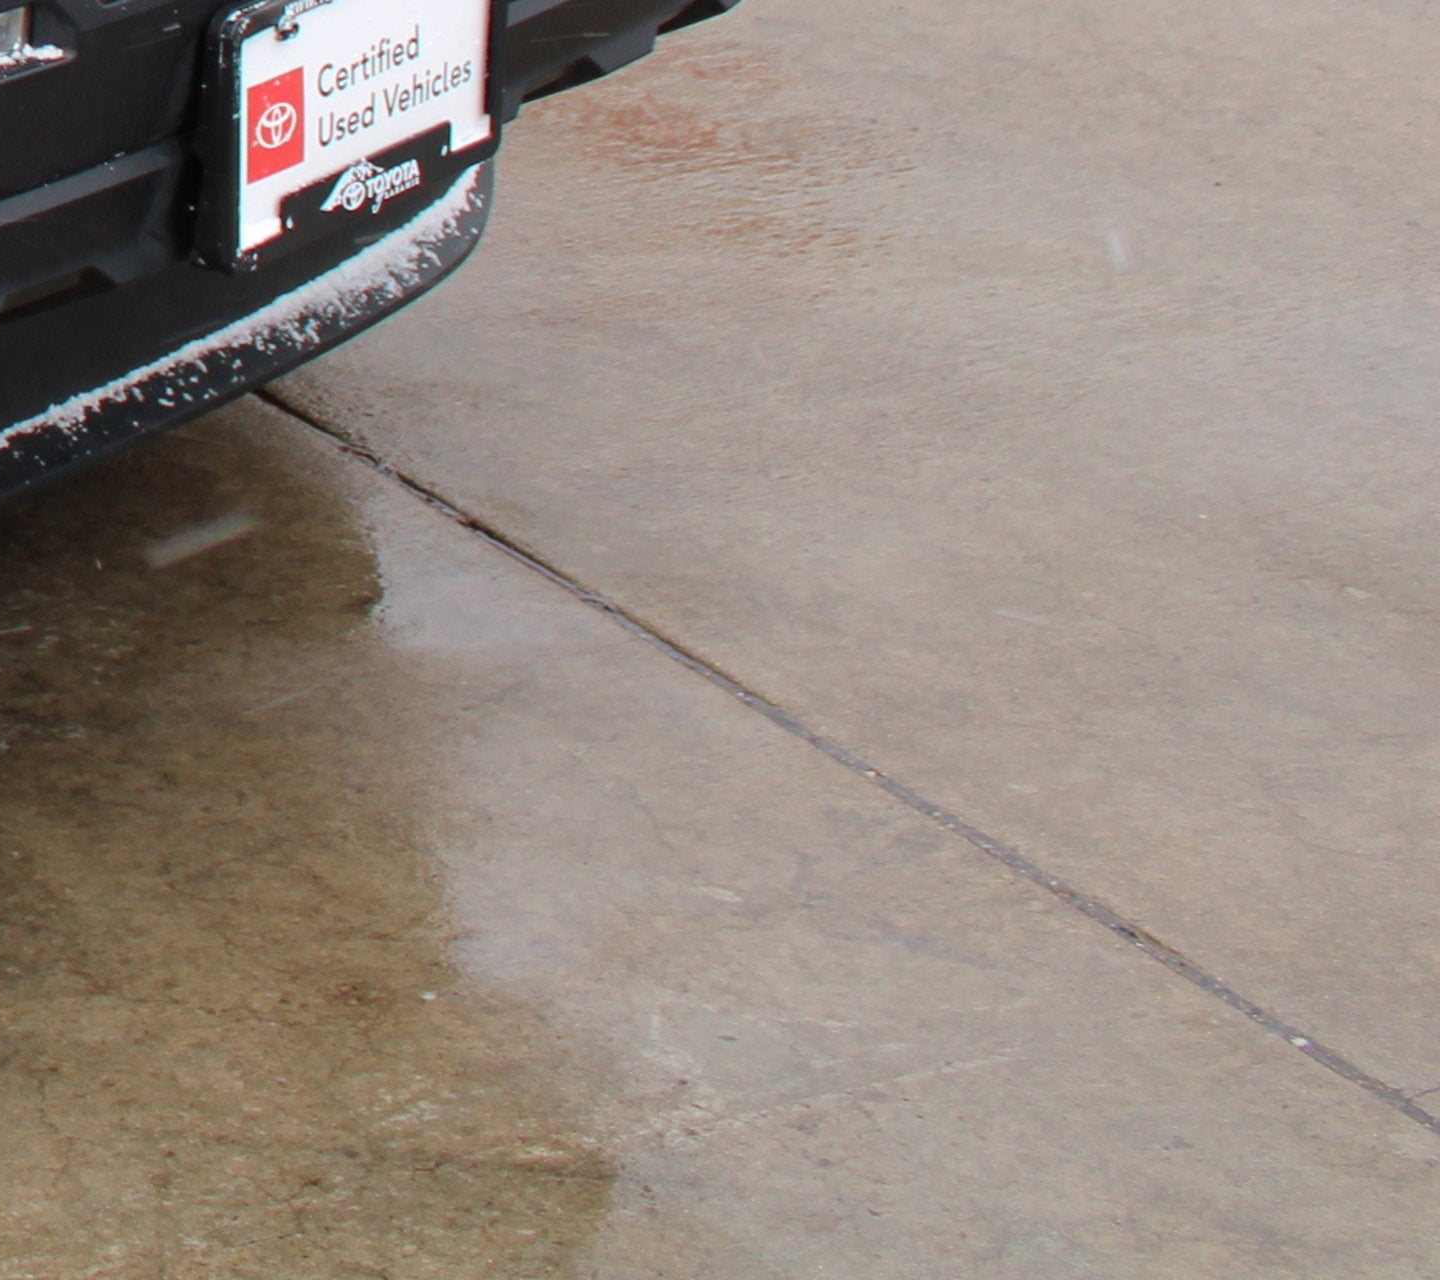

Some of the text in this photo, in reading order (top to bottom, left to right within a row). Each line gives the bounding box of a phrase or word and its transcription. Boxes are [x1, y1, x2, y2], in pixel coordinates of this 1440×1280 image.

[317, 23, 420, 97] Certified
[318, 60, 472, 146] Used Vehicles
[366, 159, 419, 198] TOYOTA
